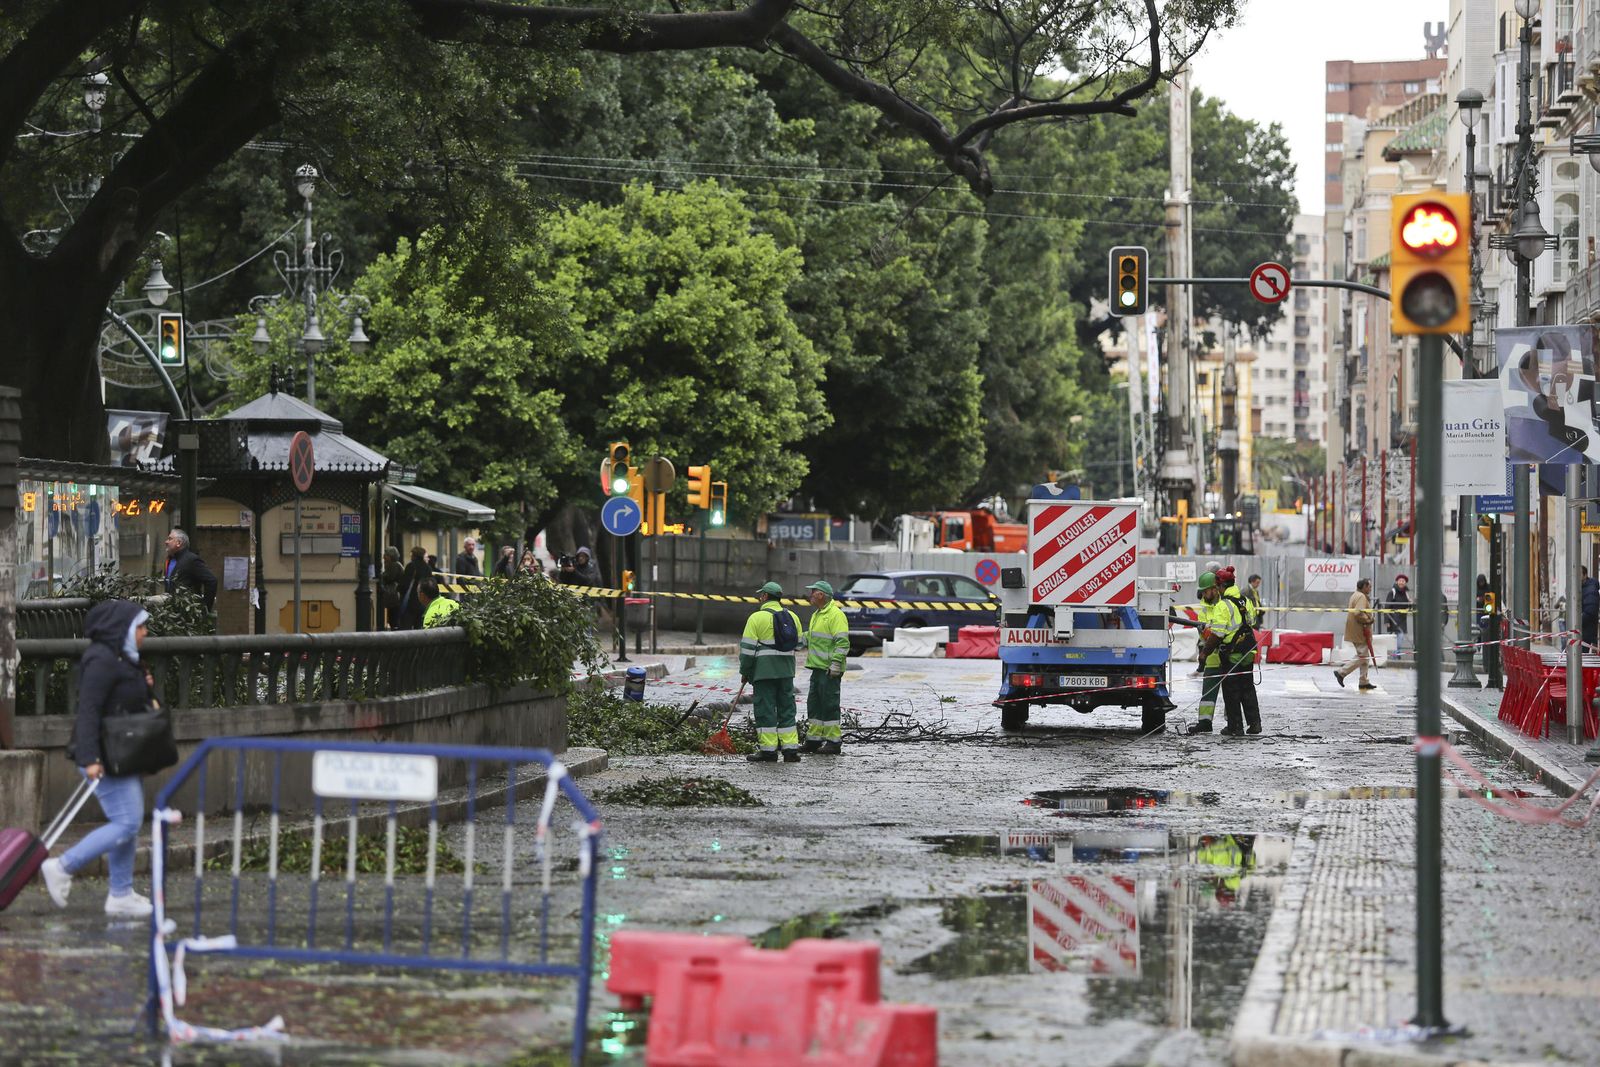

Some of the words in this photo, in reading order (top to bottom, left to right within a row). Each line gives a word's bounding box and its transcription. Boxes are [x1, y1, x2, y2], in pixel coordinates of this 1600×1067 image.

[1443, 421, 1469, 431] uan
[1472, 418, 1500, 430] Gris
[1056, 513, 1098, 547] ALQUILER
[1037, 568, 1069, 597] GRUAS
[1080, 524, 1124, 564] ALVAREZ
[1085, 577, 1103, 593] 902
[1101, 571, 1113, 581] 15
[1111, 560, 1123, 573] 84
[1121, 552, 1133, 566] 23
[1008, 630, 1069, 644] ALQUIL
[1065, 677, 1087, 686] 7803
[1089, 677, 1106, 686] KBG
